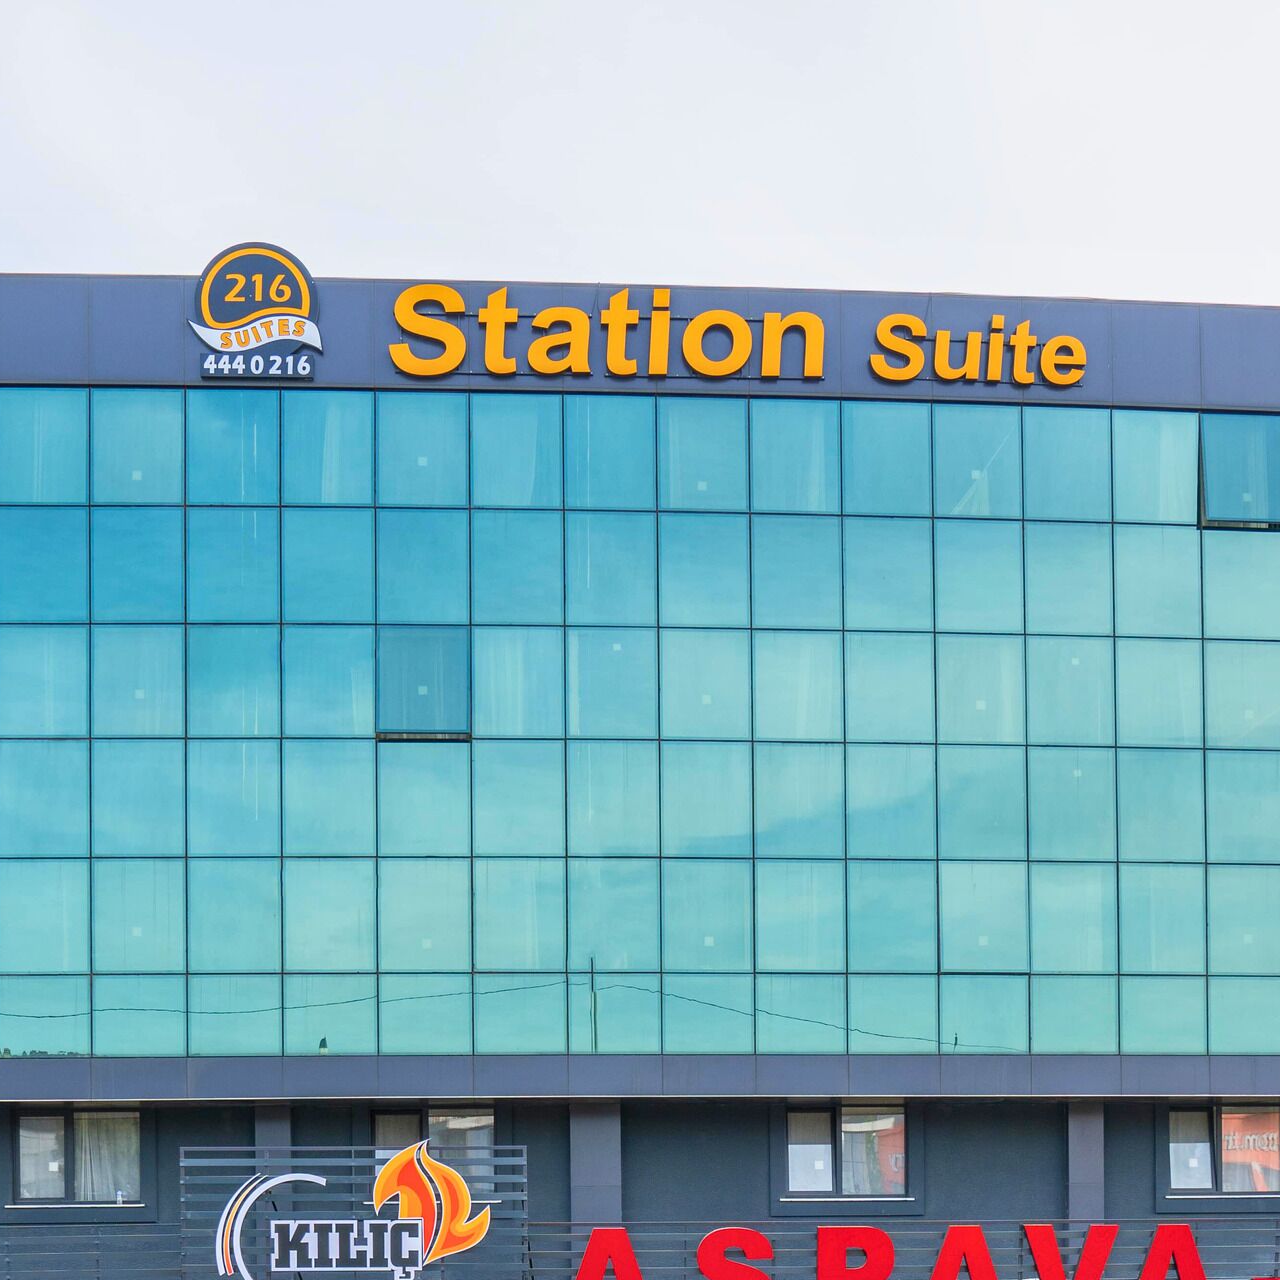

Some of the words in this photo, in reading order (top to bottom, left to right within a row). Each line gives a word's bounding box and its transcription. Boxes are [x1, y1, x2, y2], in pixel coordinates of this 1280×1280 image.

[224, 273, 292, 303] 216
[220, 318, 307, 350] SUITES
[388, 283, 825, 378] Station
[869, 313, 1088, 387] Suite
